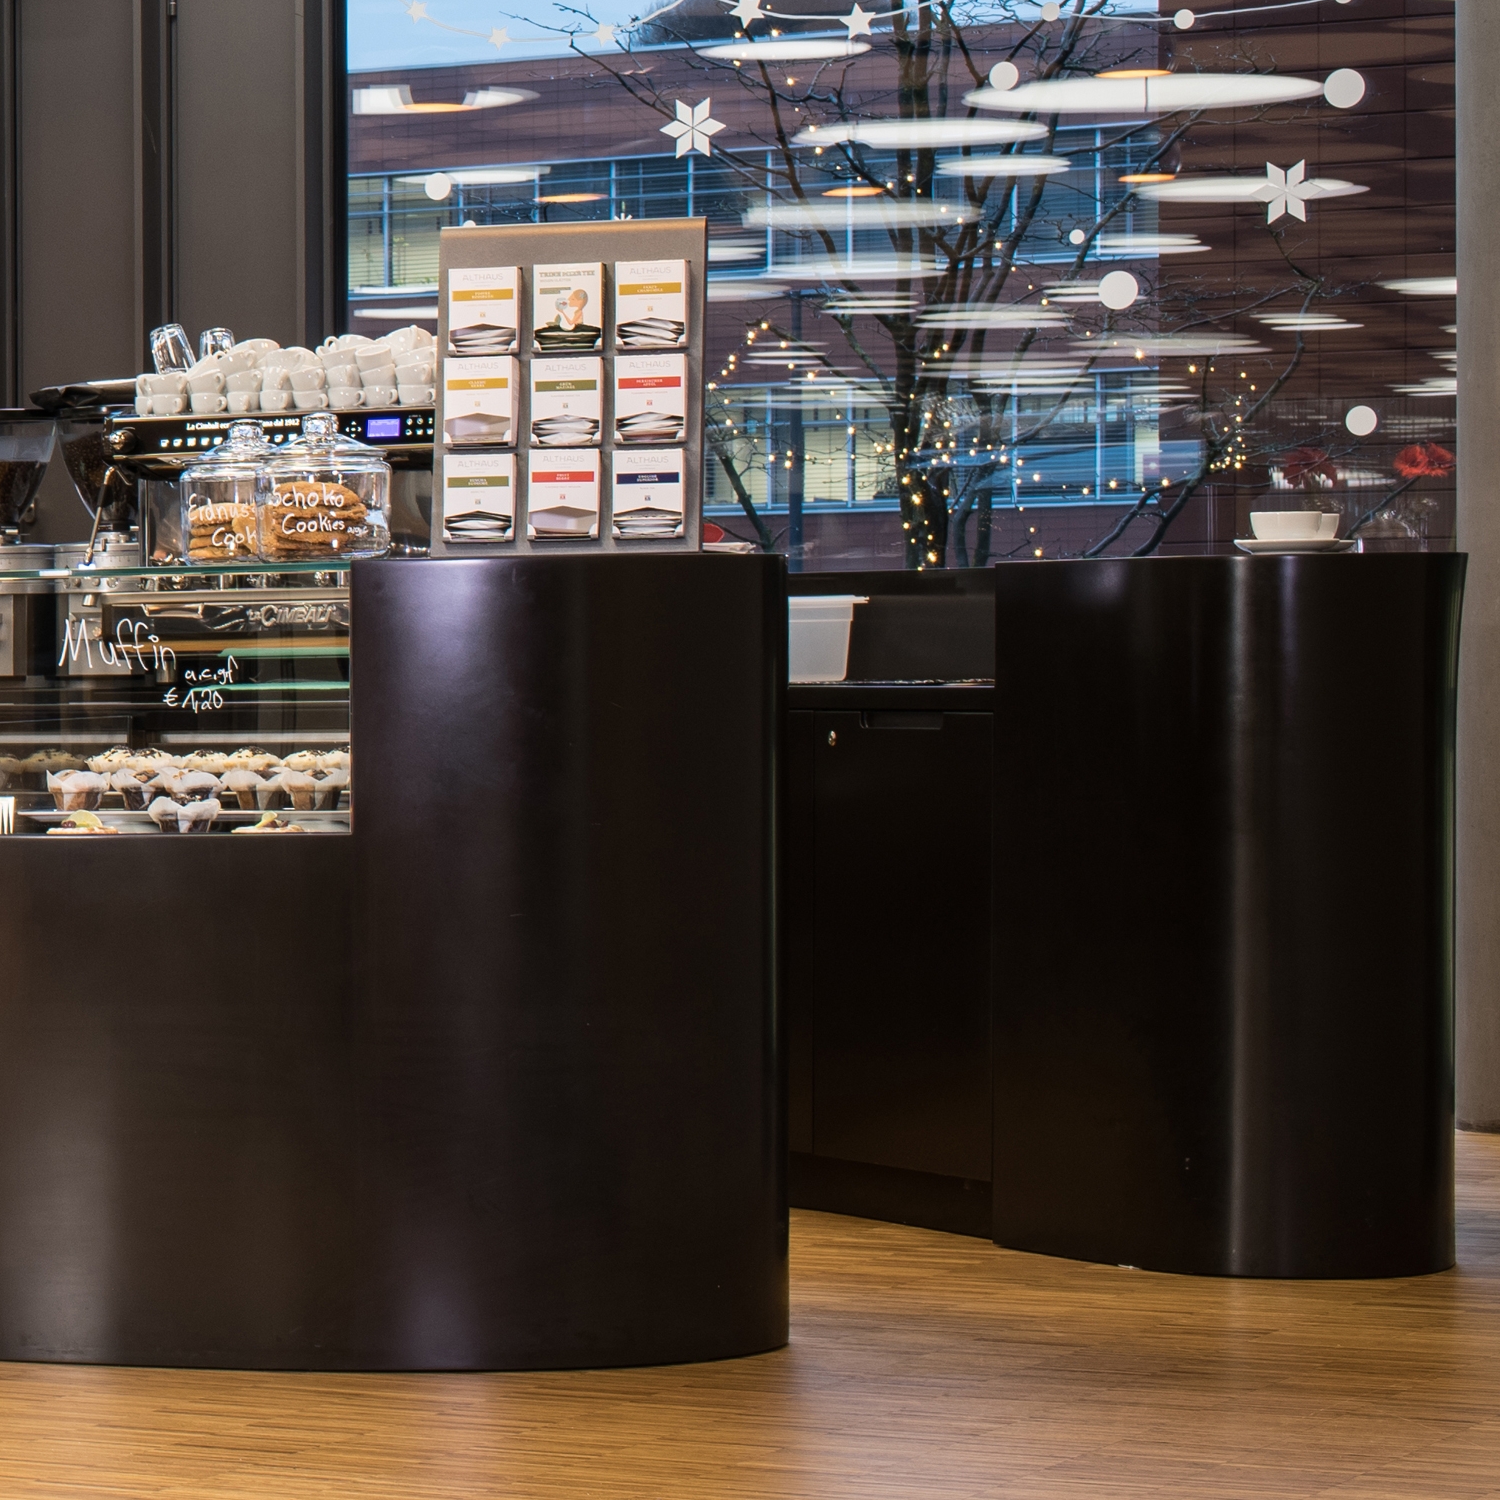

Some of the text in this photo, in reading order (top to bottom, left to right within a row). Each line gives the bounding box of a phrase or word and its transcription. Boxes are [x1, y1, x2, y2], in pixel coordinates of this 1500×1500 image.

[271, 483, 345, 509] Schoko
[282, 512, 345, 534] Cookies
[58, 618, 177, 672] Muffin
